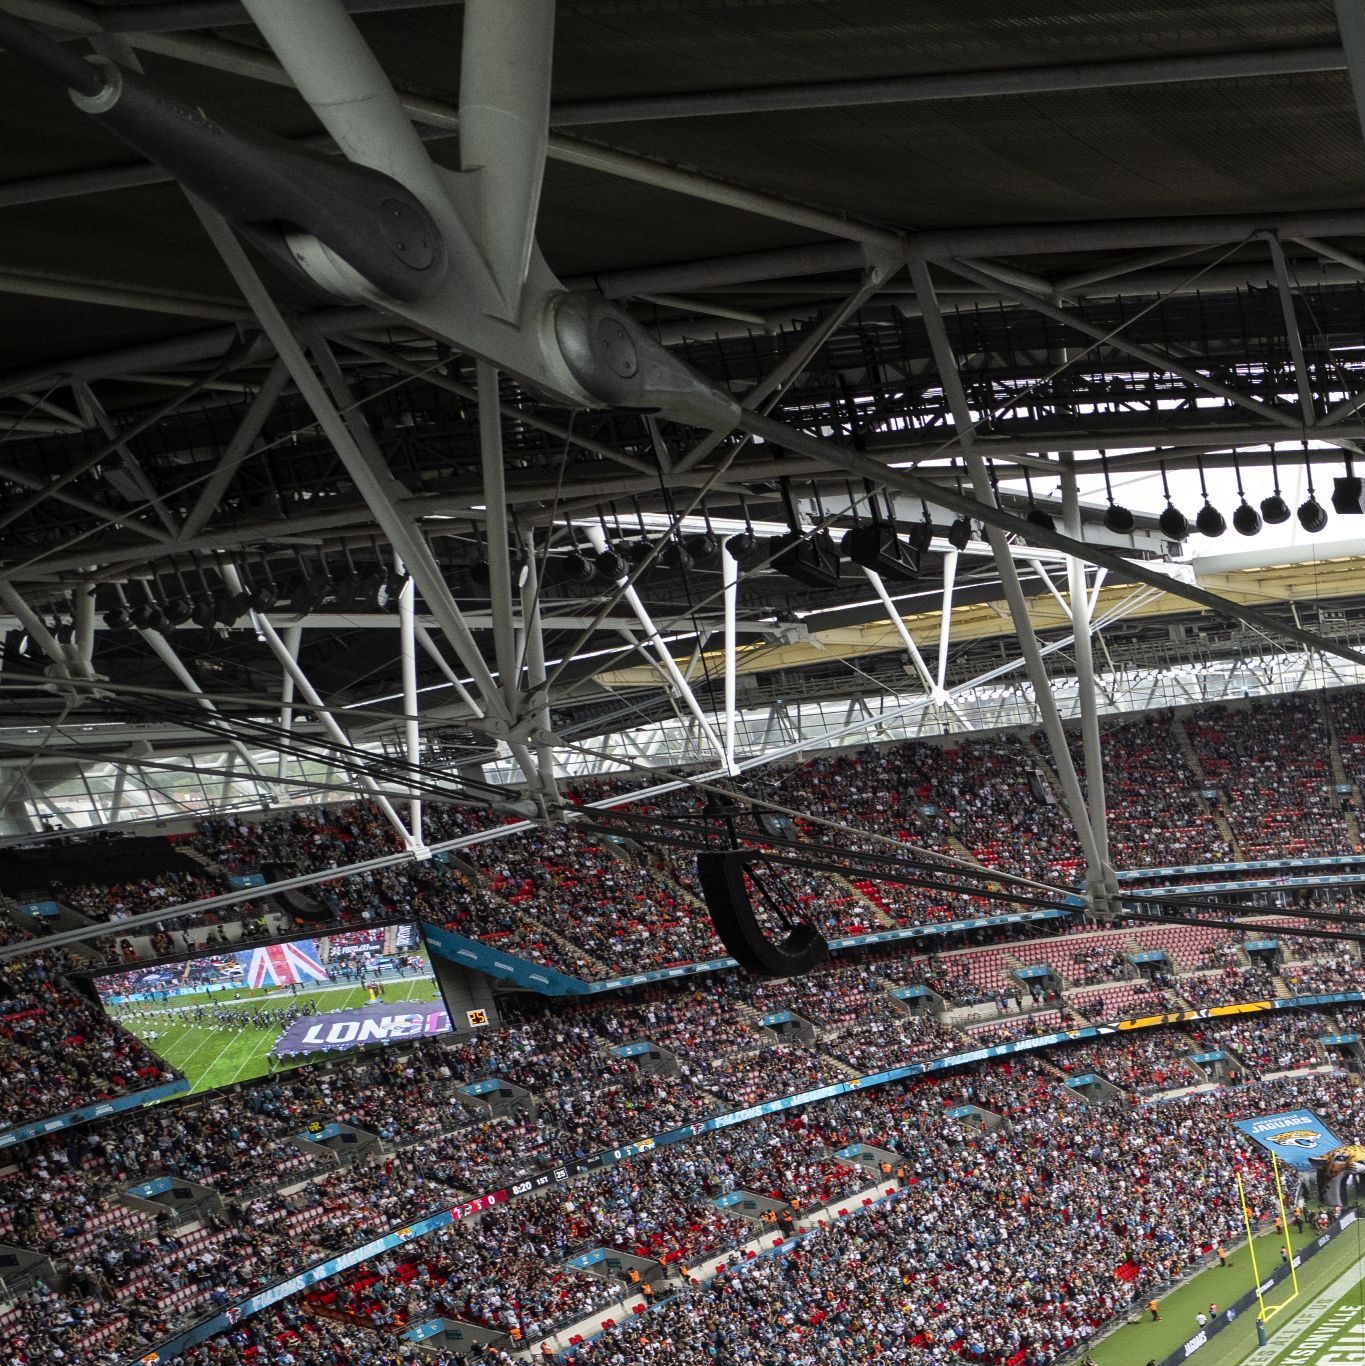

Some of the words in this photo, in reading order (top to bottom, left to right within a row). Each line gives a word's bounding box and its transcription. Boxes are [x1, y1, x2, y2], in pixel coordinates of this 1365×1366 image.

[469, 1010, 486, 1024] 25
[1252, 1116, 1313, 1134] JAGUARS
[512, 1181, 532, 1195] 8:20
